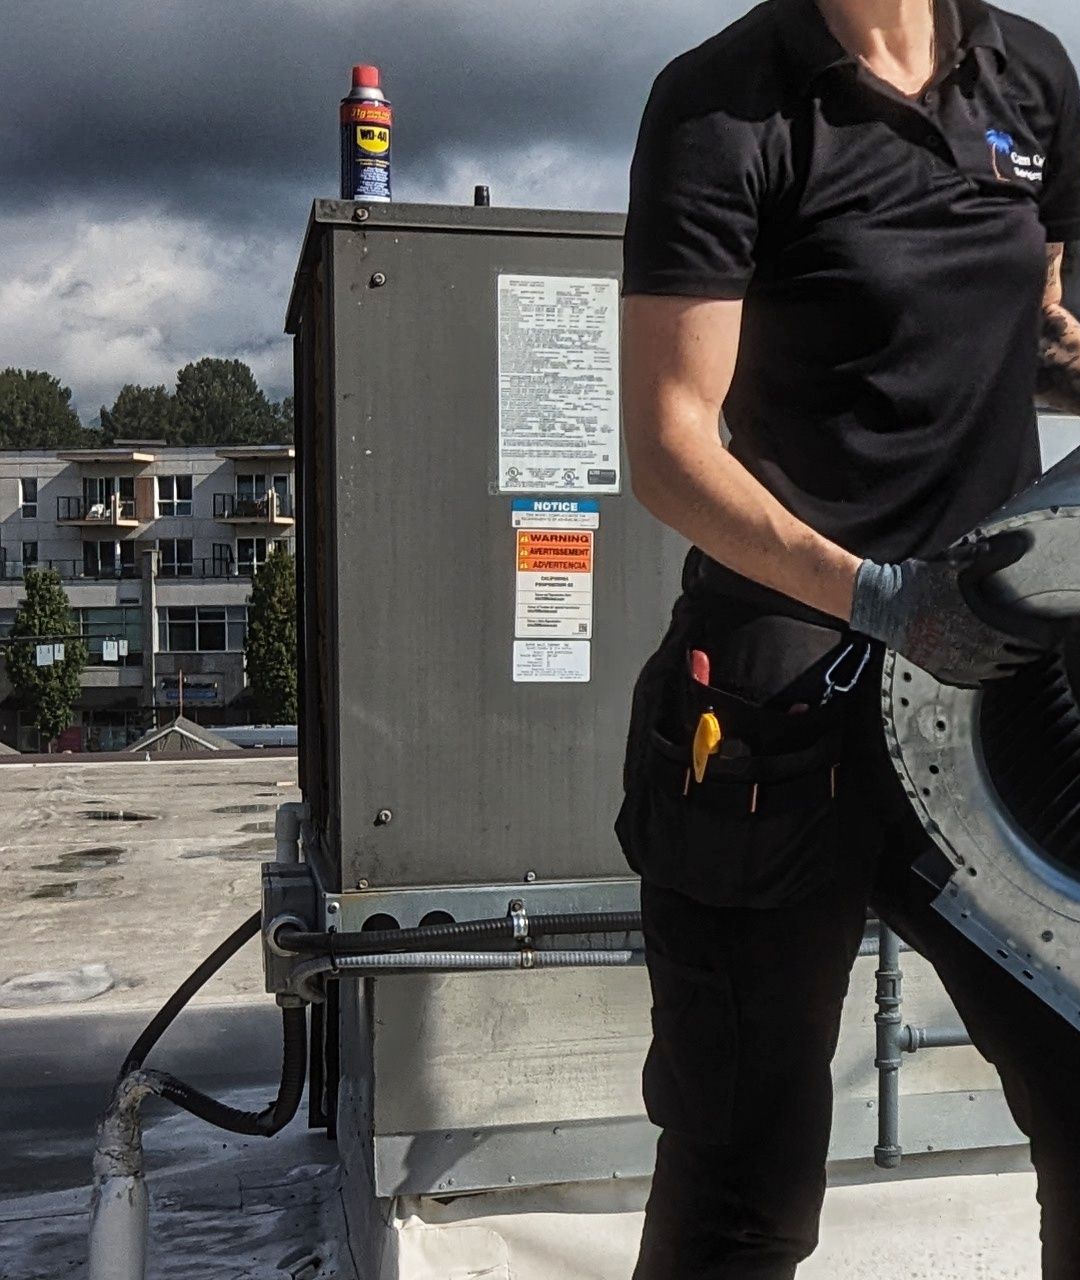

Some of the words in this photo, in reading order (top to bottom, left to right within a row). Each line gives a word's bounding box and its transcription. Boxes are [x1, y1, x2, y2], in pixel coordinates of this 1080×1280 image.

[360, 129, 387, 142] WD-40
[534, 502, 579, 511] NOTICE
[530, 534, 589, 543] WARNING
[530, 547, 590, 556] AVERTISSEMENT
[533, 561, 587, 569] ADVERTENCIA
